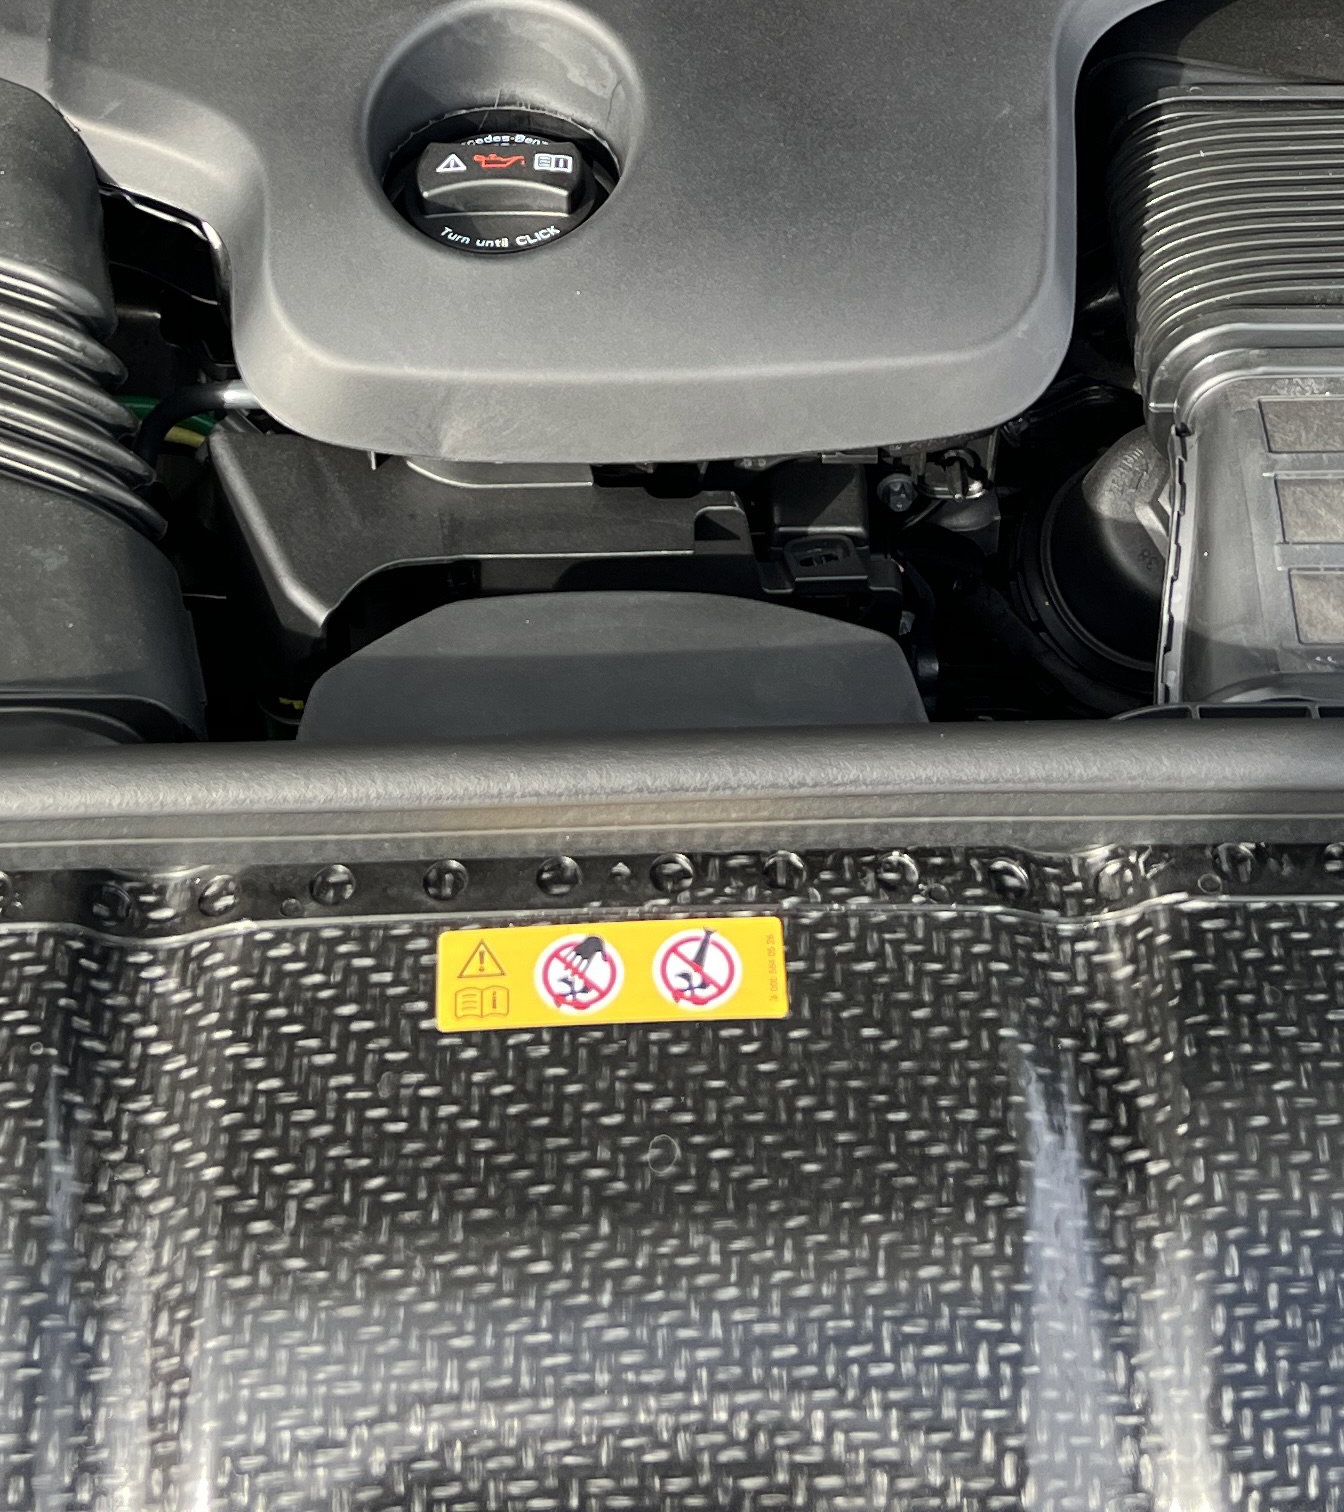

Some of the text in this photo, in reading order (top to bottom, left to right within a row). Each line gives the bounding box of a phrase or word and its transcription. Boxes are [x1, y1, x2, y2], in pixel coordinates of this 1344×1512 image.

[460, 133, 549, 146] cedes-Benz
[440, 225, 561, 248] Turn until CLICK
